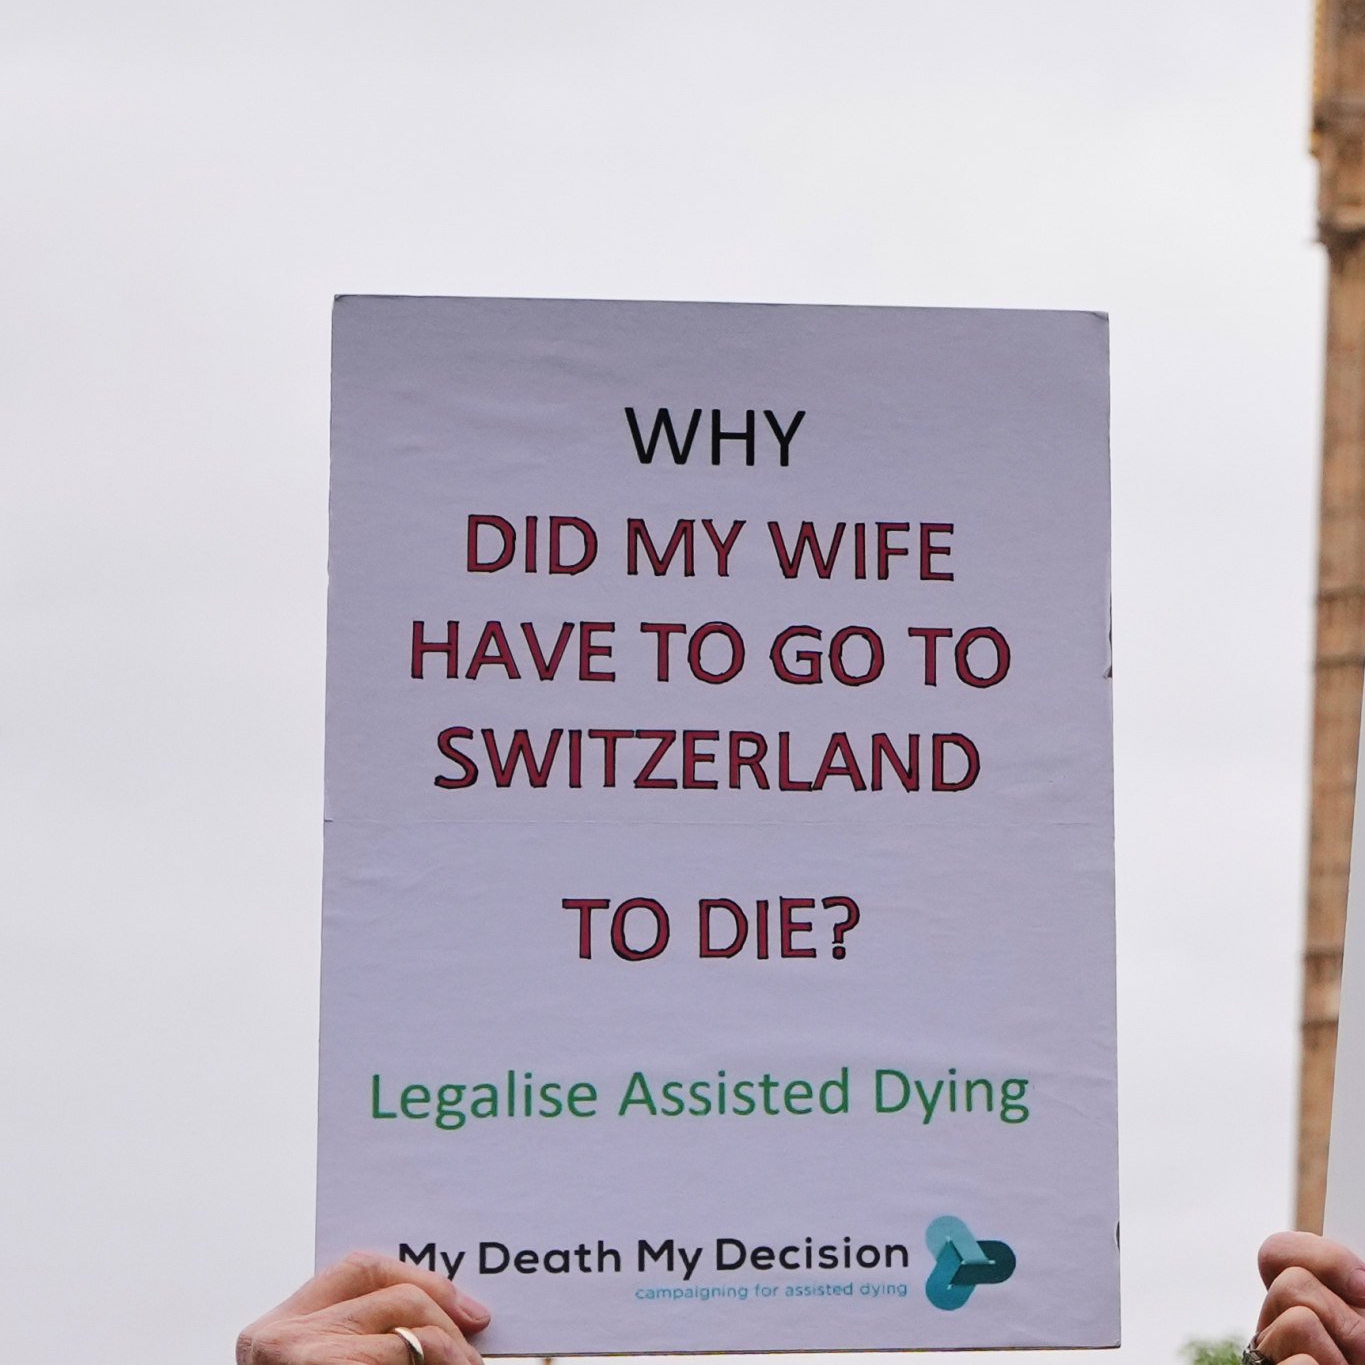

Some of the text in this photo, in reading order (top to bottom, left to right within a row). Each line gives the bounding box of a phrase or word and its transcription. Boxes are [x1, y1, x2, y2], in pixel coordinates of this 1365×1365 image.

[625, 407, 806, 466] WHY
[467, 514, 954, 581] DID MY WIFE
[411, 620, 1010, 688] HAVE TO GO TO
[434, 726, 980, 793] SWITZERLAND
[562, 896, 860, 961] TO DIE?
[372, 1067, 1029, 1130] Legalise Assisted Dying
[399, 1237, 908, 1281] My Death My Decision
[635, 1282, 908, 1301] campaigning for assisted dying
